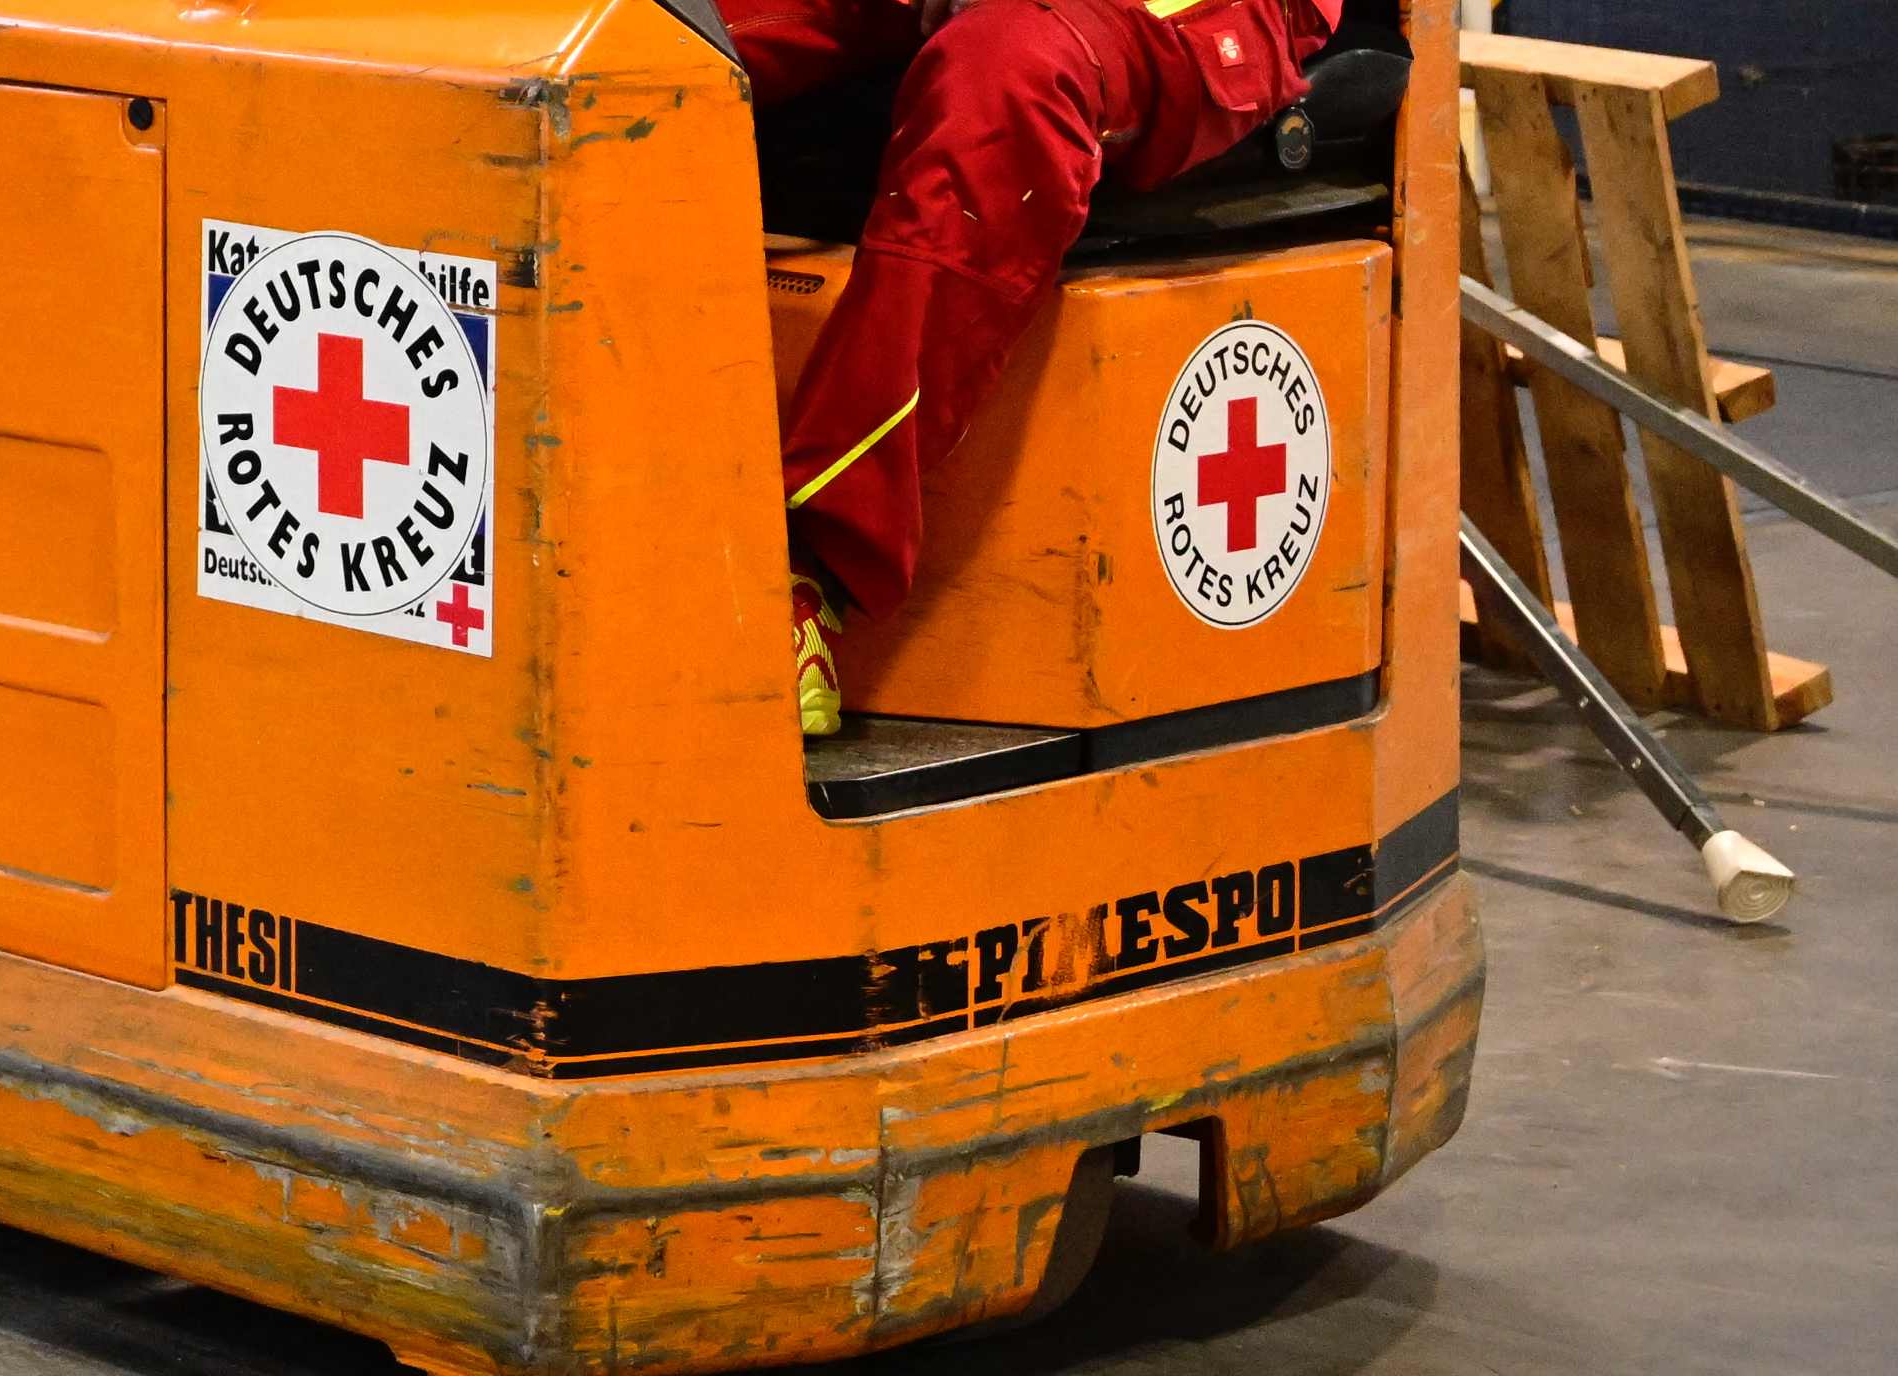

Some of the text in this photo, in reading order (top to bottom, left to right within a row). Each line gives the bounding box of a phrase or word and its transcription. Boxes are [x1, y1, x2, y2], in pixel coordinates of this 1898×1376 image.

[208, 229, 270, 276] Kat
[224, 259, 459, 399] DEUTSCHES
[1167, 341, 1315, 453] DEUTSCHES
[217, 413, 469, 592] ROTES KREUZ
[1164, 473, 1318, 607] ROTES KREUZ
[169, 888, 291, 992] THESI
